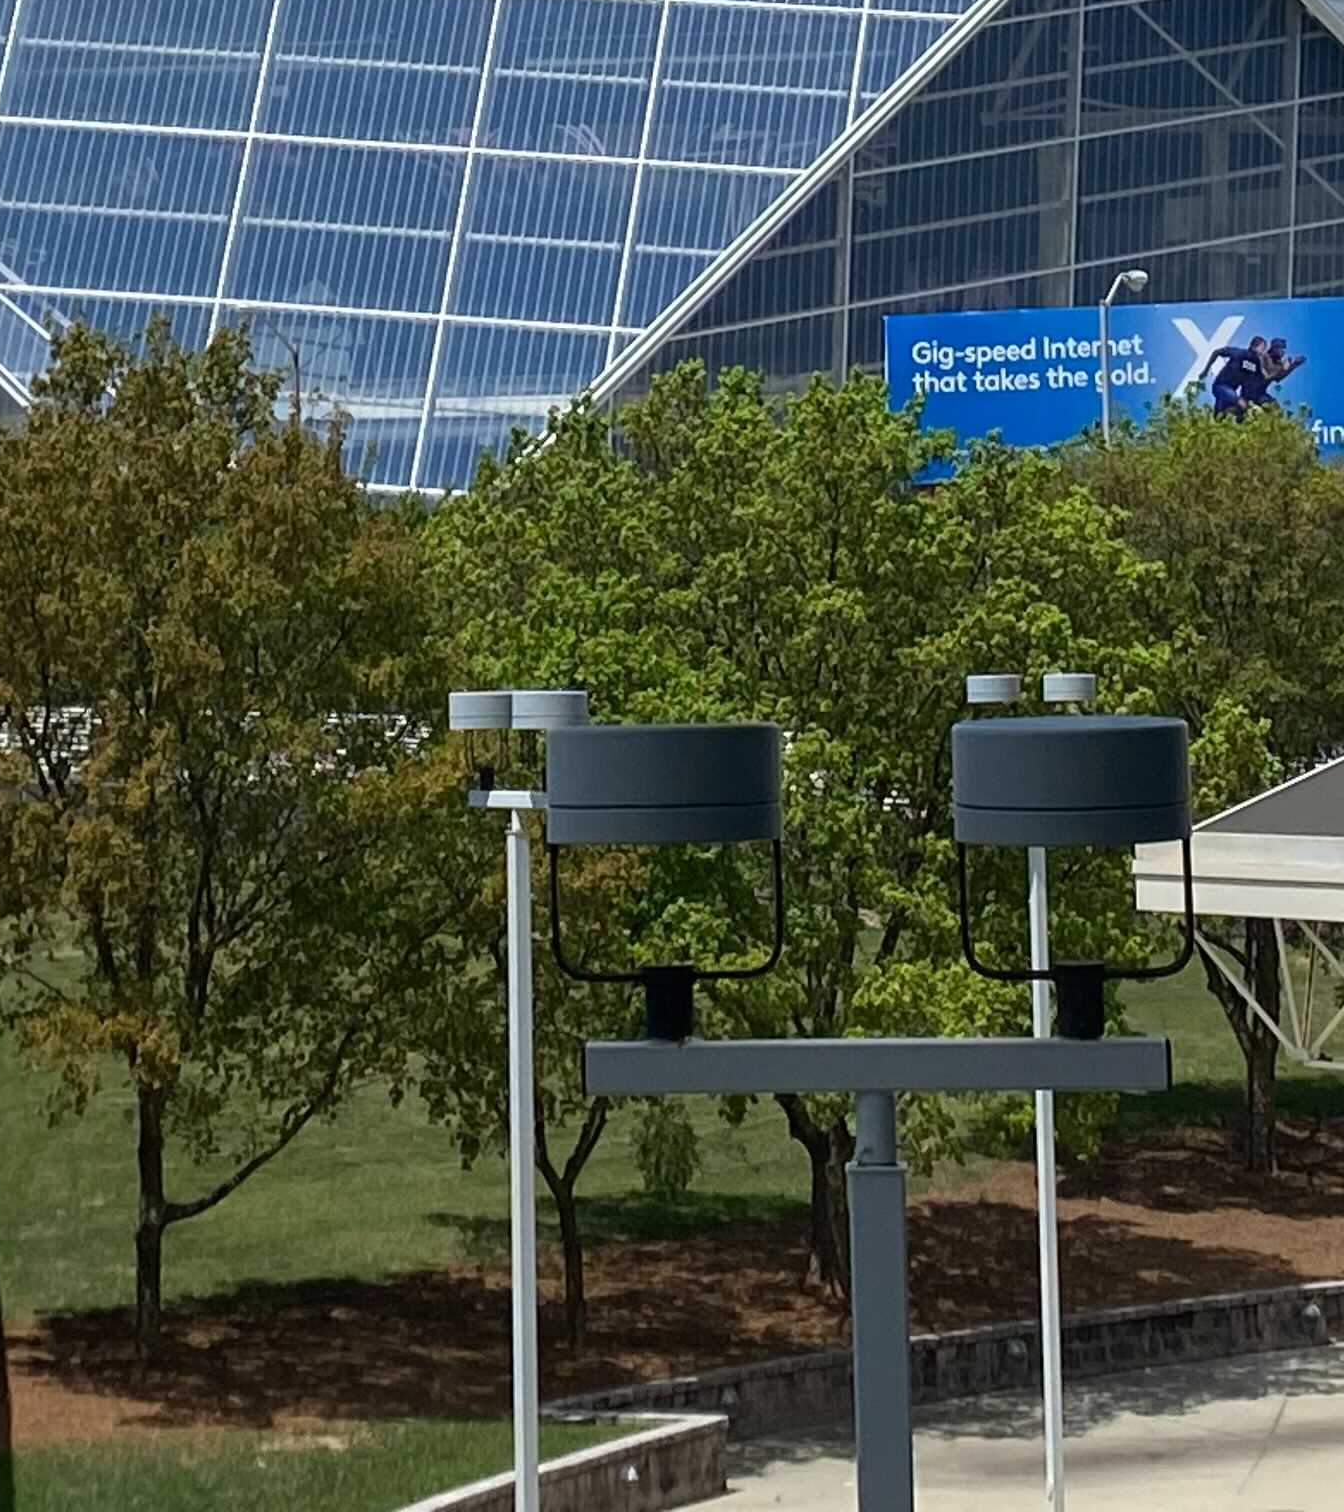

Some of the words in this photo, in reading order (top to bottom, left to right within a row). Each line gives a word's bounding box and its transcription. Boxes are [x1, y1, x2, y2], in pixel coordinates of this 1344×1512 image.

[911, 337, 1037, 370] Gig-speed
[1043, 334, 1144, 360] Internet
[911, 370, 968, 393] that
[972, 368, 1041, 392] takes
[1045, 365, 1089, 389] the
